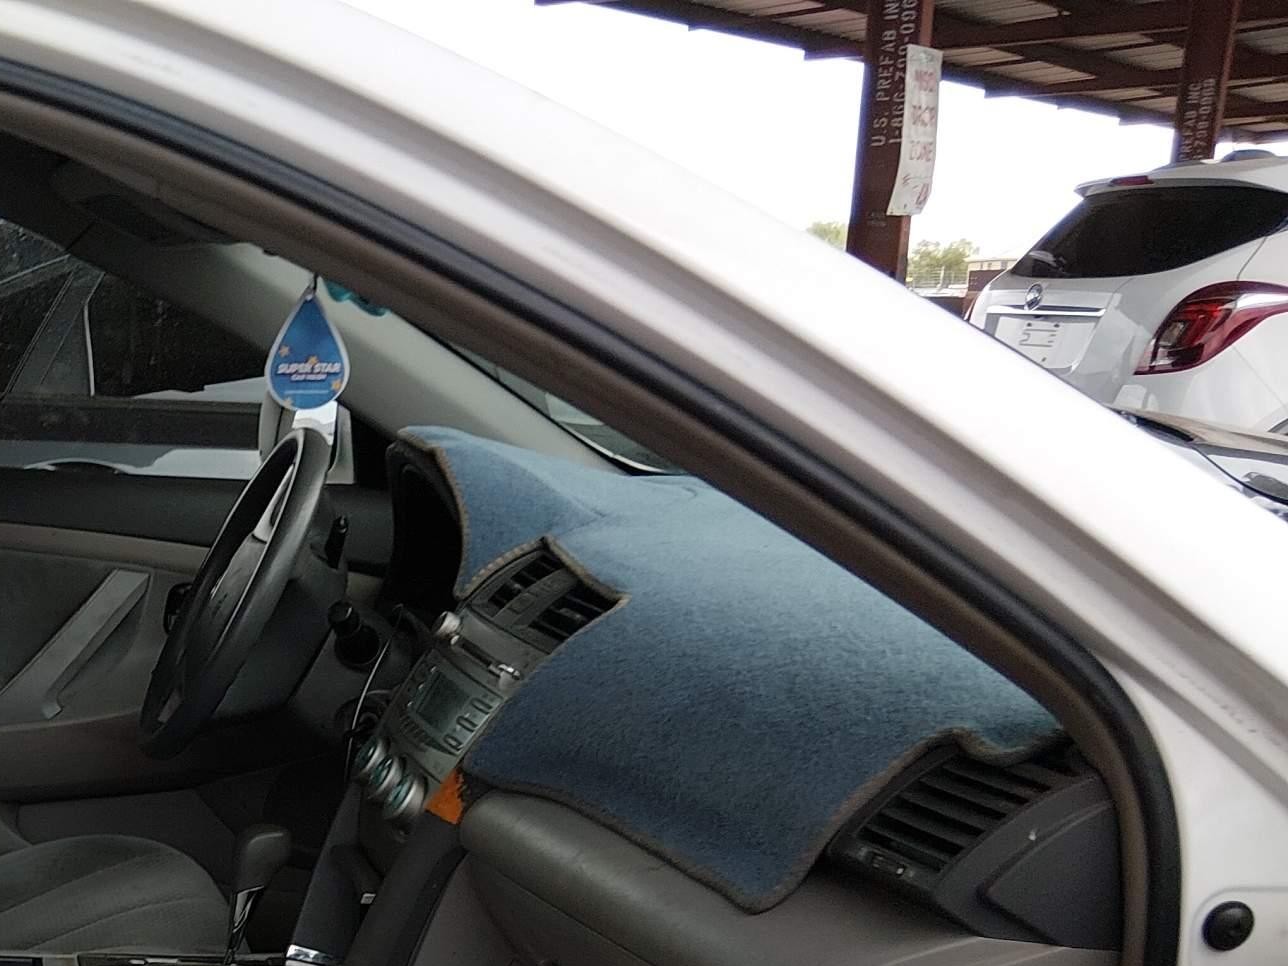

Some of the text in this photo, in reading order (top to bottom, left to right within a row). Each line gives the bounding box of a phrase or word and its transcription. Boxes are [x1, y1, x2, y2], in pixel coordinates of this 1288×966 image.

[883, 0, 902, 20] IN
[876, 30, 897, 102] PREFAB
[277, 362, 341, 374] SUPER STAR
